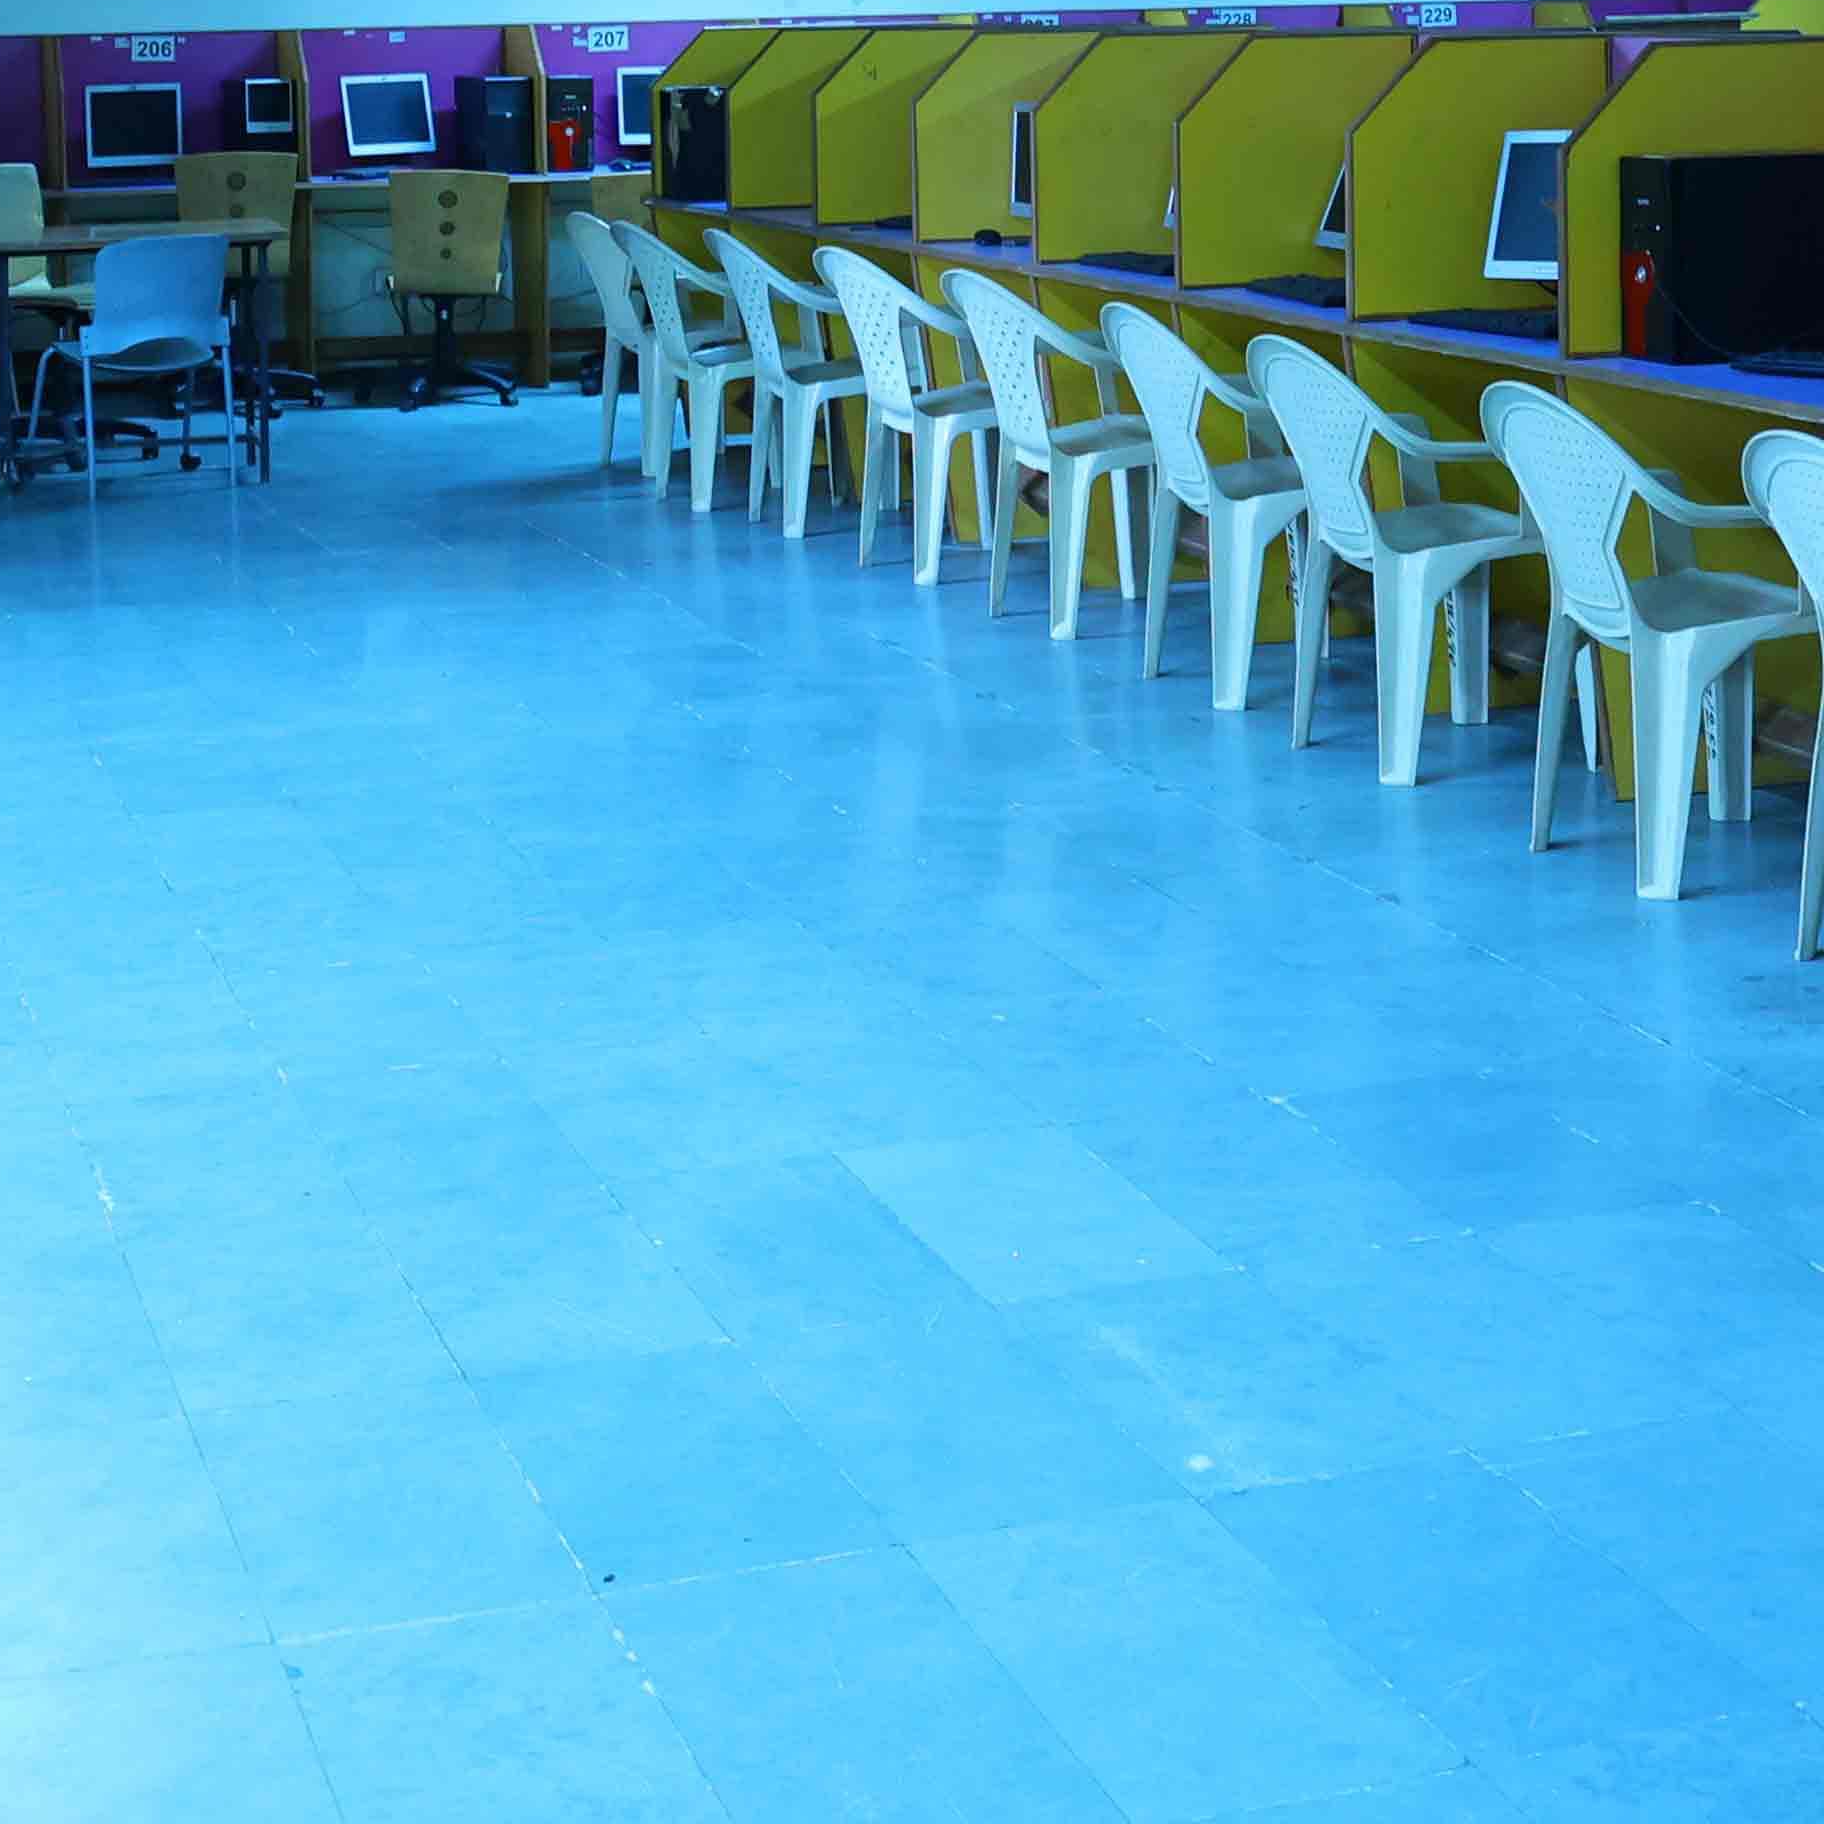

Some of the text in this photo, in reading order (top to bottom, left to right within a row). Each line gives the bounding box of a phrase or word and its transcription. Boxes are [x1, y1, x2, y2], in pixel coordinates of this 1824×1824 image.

[1424, 7, 1452, 23] 229
[593, 31, 624, 47] 207
[137, 41, 172, 57] 206
